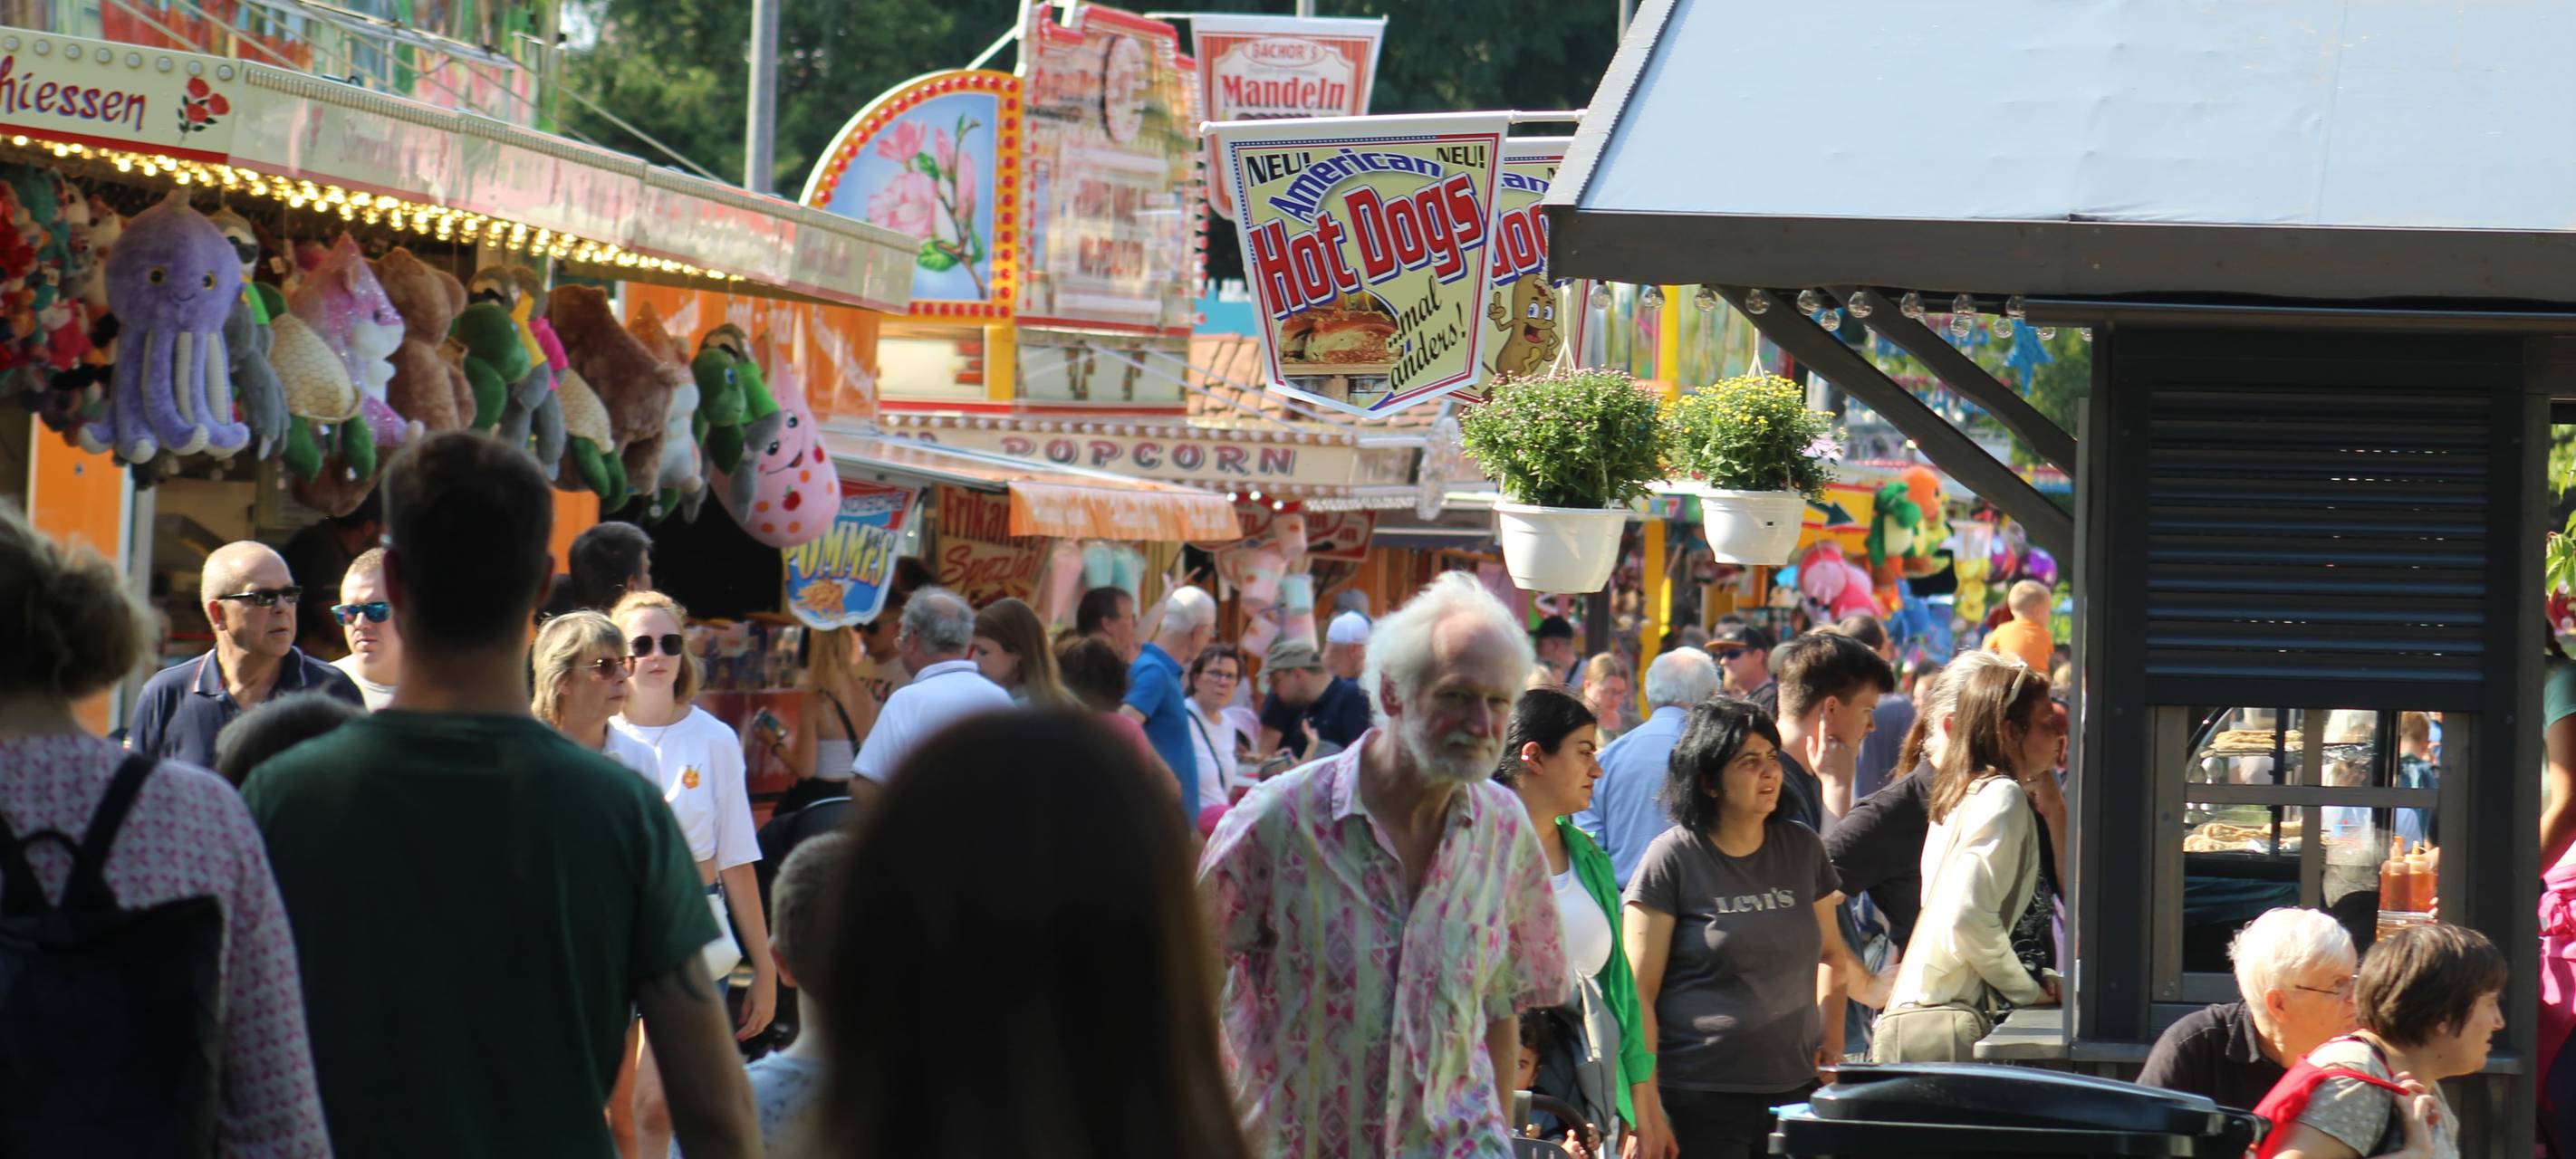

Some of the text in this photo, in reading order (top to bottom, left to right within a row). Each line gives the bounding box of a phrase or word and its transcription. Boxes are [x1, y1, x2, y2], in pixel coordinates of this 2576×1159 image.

[1220, 75, 1345, 110] Mandeln
[1245, 152, 1312, 187] NEU!
[1435, 145, 1485, 169] NEU!
[1267, 148, 1445, 225] American
[1247, 210, 1363, 321] Hot
[1341, 171, 1488, 287] Dogs
[1390, 302, 1466, 390] anders!
[999, 436, 1297, 475] POPCORN
